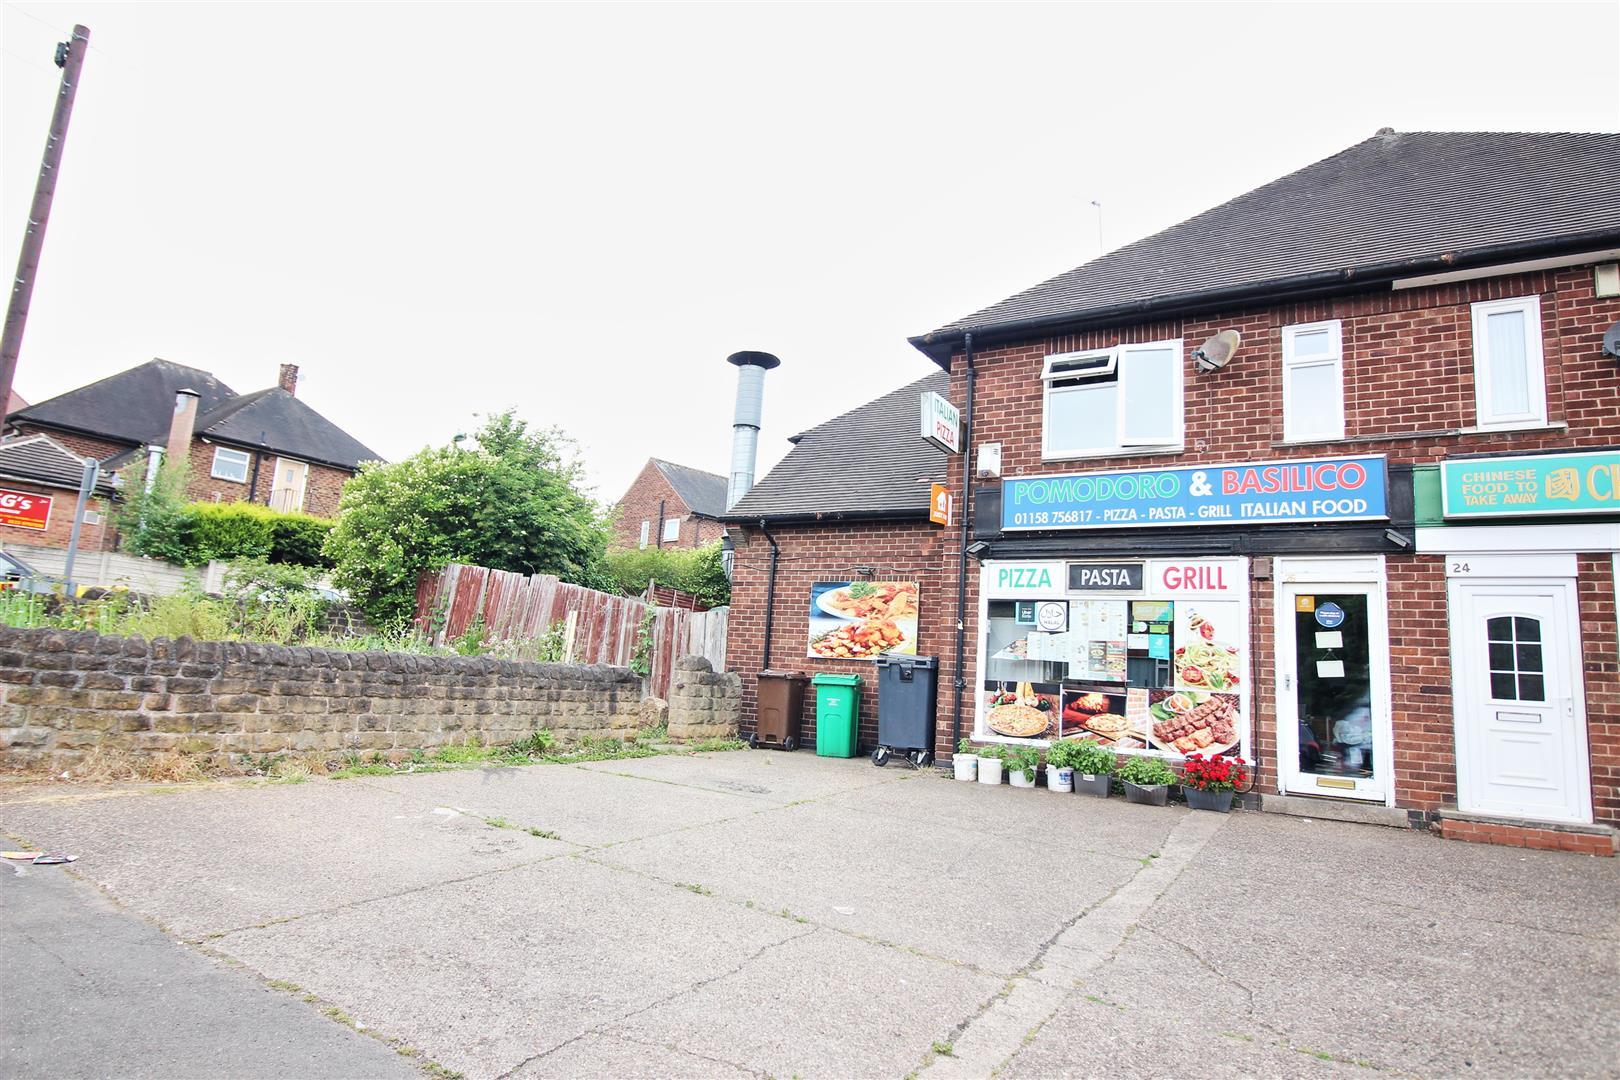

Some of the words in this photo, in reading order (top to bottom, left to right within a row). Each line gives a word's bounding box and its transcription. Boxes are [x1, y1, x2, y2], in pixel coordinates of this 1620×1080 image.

[934, 398, 958, 428] ITALIAN
[936, 420, 954, 446] PIZZA
[1014, 474, 1179, 505] POMODORO
[1189, 470, 1213, 496] &
[1221, 463, 1367, 495] BASILICO
[1461, 469, 1537, 483] CHINESE
[1461, 483, 1509, 495] FOOD
[1515, 481, 1538, 492] TO
[1463, 494, 1498, 507] TAKE
[1503, 492, 1538, 504] AWAY
[1014, 511, 1049, 525] 01158
[1052, 510, 1093, 524] 756817
[1103, 508, 1138, 522] PIZZA
[1149, 506, 1187, 520] PASTA
[1197, 504, 1233, 518] GRILL
[1240, 500, 1306, 517] ITALIAN
[1312, 498, 1368, 515] FOOD
[998, 568, 1052, 589] PIZZA
[1080, 568, 1131, 587] PASTA
[1162, 566, 1228, 590] GRILL
[1452, 562, 1471, 574] 24
